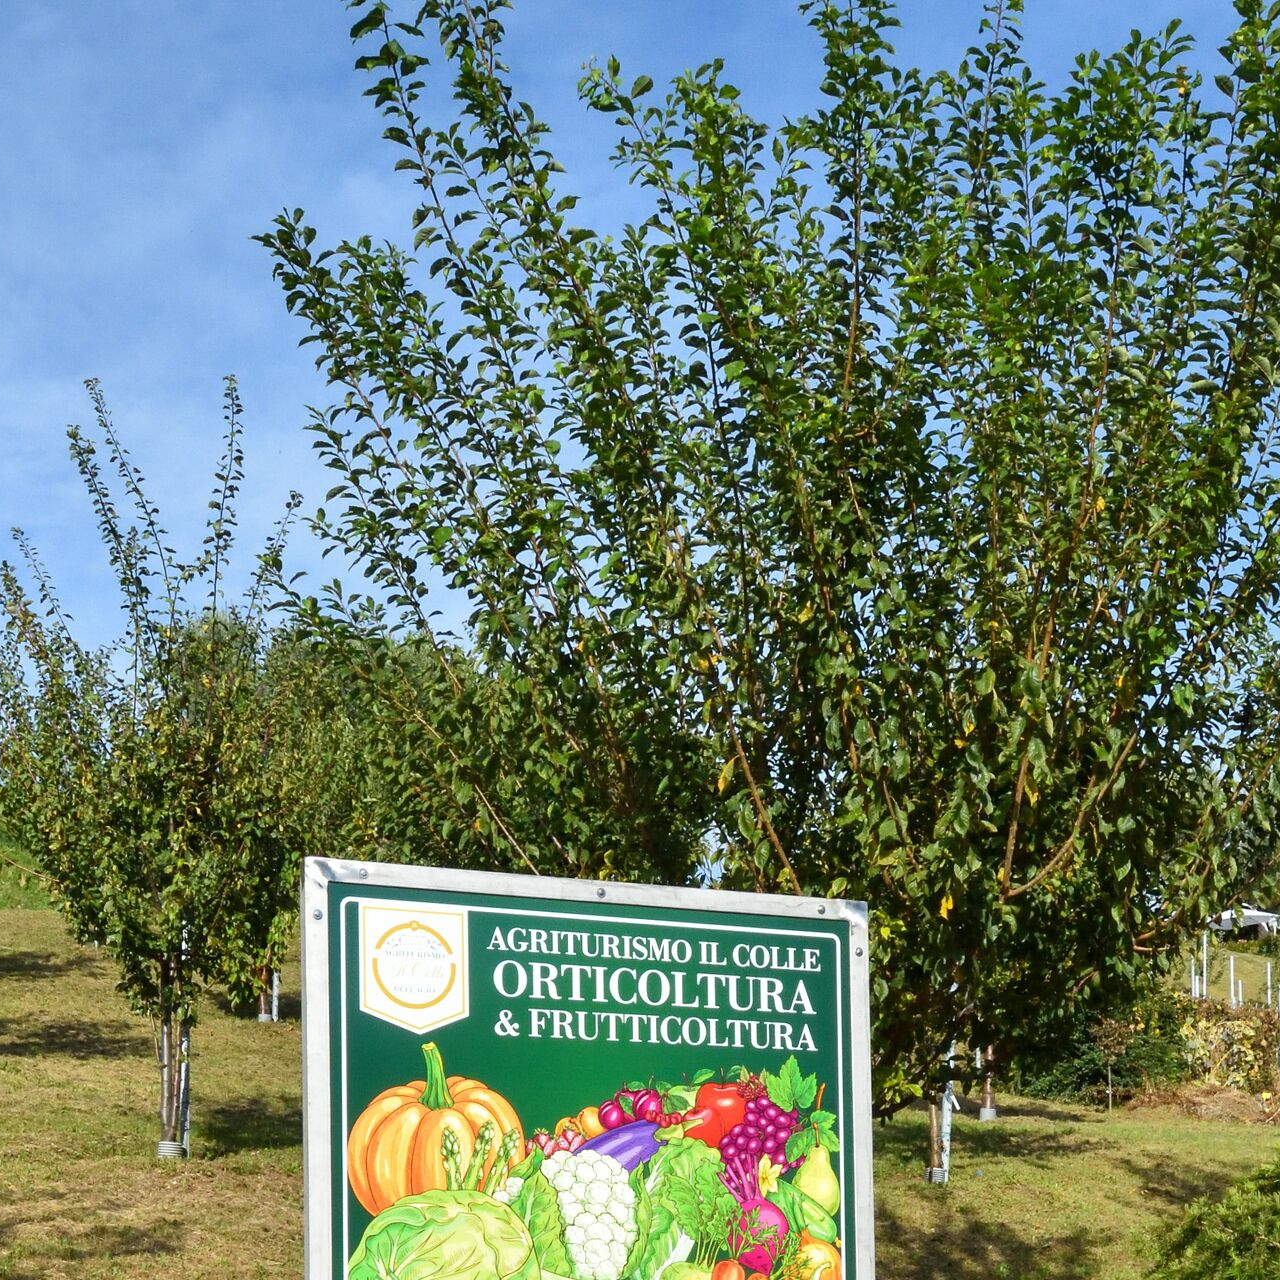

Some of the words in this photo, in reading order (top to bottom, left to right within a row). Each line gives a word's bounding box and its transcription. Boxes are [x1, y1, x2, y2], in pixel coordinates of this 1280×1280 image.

[487, 927, 692, 963] AGRITURISMO
[699, 942, 728, 966] IL
[732, 944, 821, 971] COLLE
[493, 960, 817, 1014] ORTICOLTURA
[494, 1010, 520, 1036] &
[528, 1009, 818, 1051] FRUTTICOLTURA
